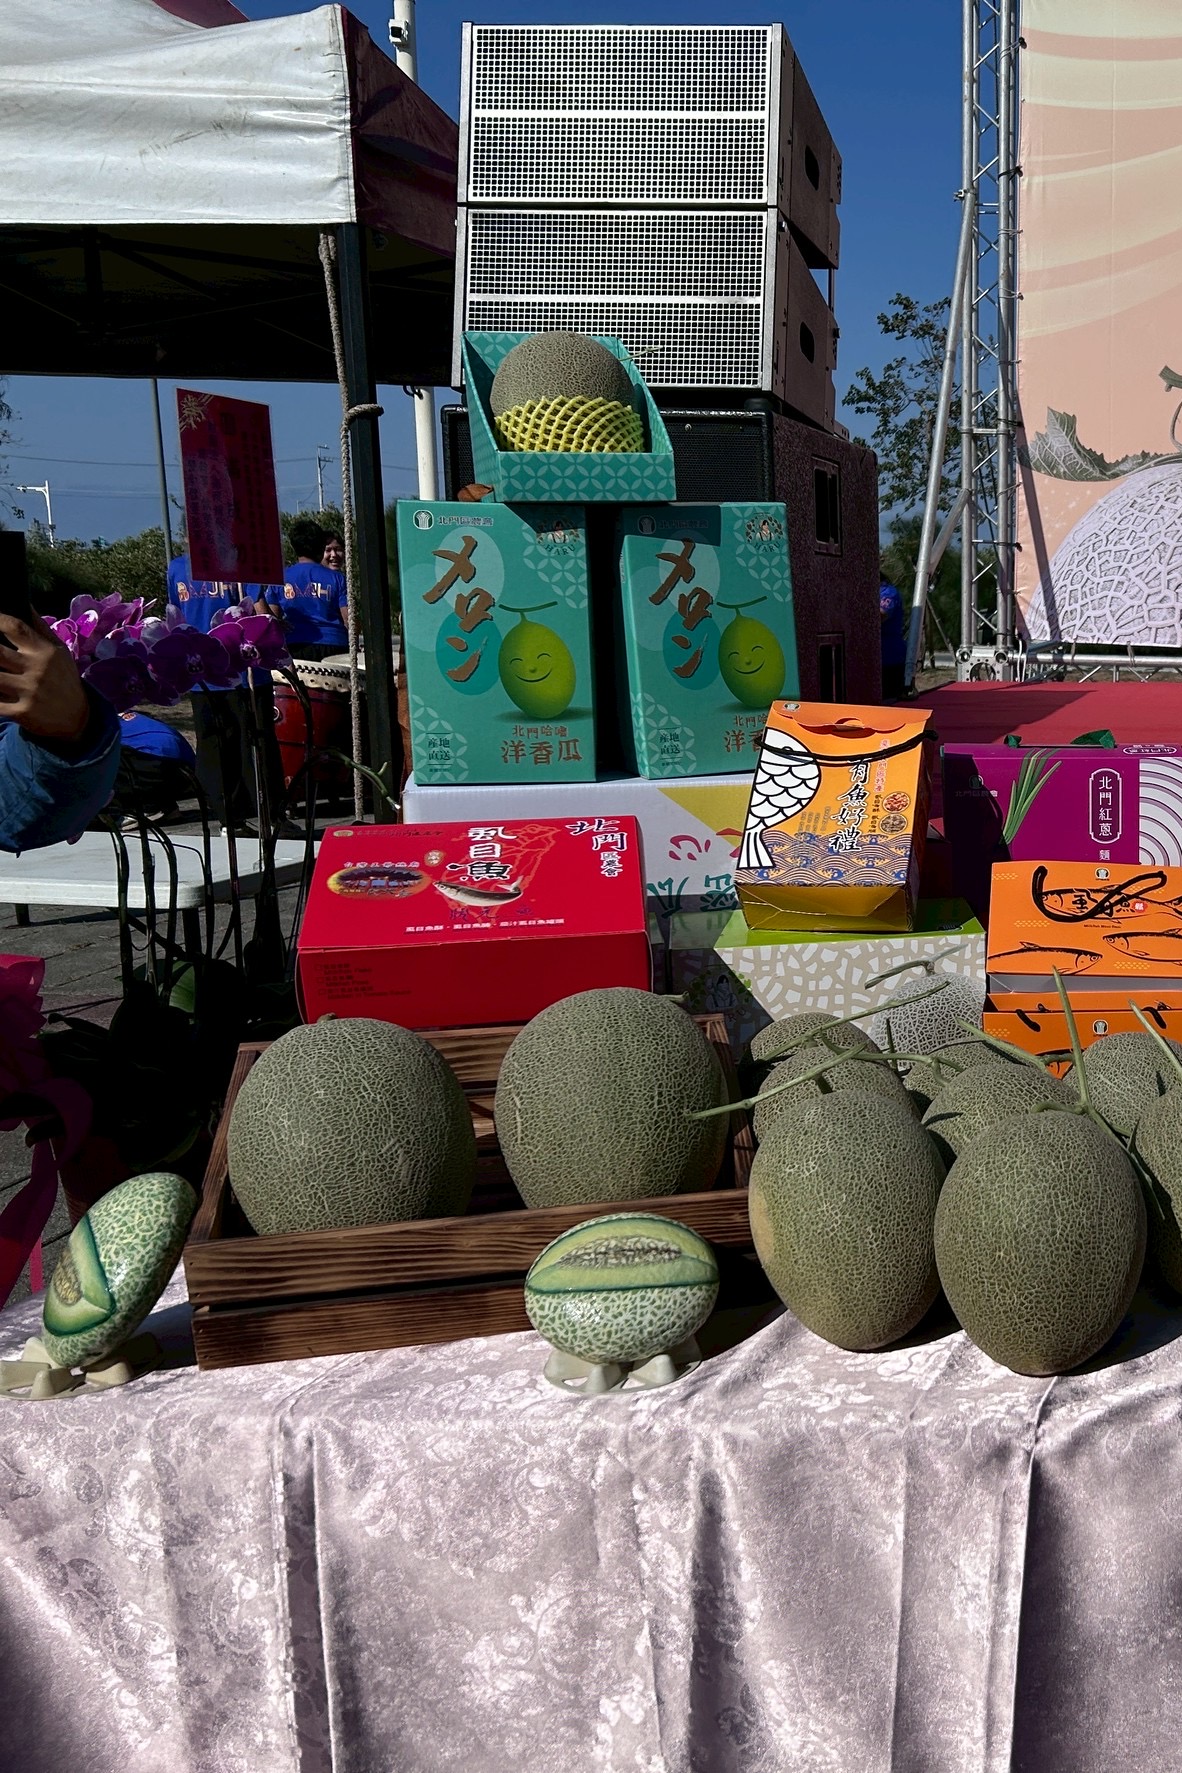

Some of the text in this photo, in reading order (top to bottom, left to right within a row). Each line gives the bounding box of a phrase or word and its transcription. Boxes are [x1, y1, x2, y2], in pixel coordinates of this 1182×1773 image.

[422, 536, 496, 683] メロン
[649, 537, 714, 679] メロン
[501, 739, 582, 765] 洋香瓜
[1099, 776, 1113, 836] 北門紅蔥
